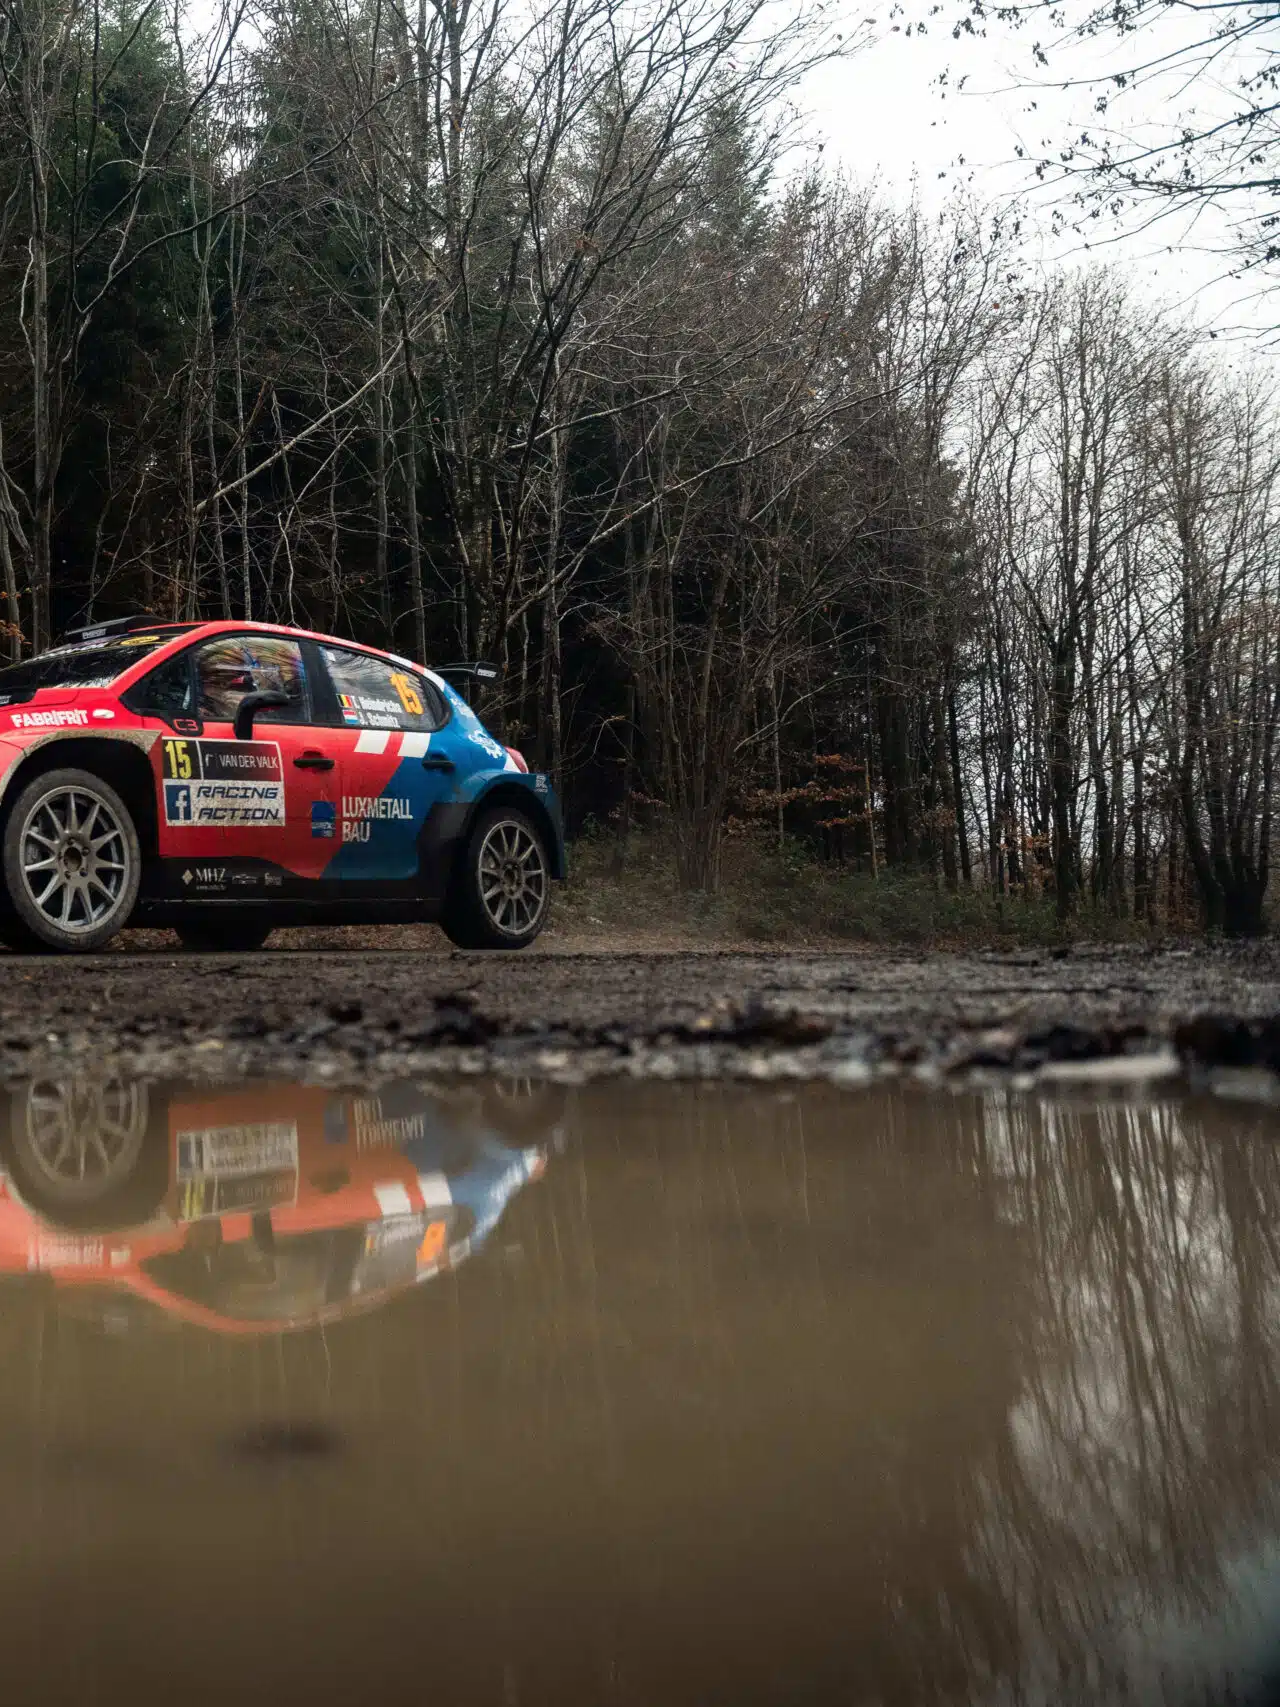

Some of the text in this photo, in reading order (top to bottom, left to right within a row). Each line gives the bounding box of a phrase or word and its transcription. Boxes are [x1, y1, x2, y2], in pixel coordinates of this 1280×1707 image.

[390, 673, 423, 715] 15
[165, 740, 192, 779] 15
[219, 754, 279, 769] VAN DER VALK
[197, 785, 278, 799] RACING
[198, 807, 279, 820] ACTION
[342, 796, 413, 819] LUXMETALL
[342, 821, 371, 842] BAU
